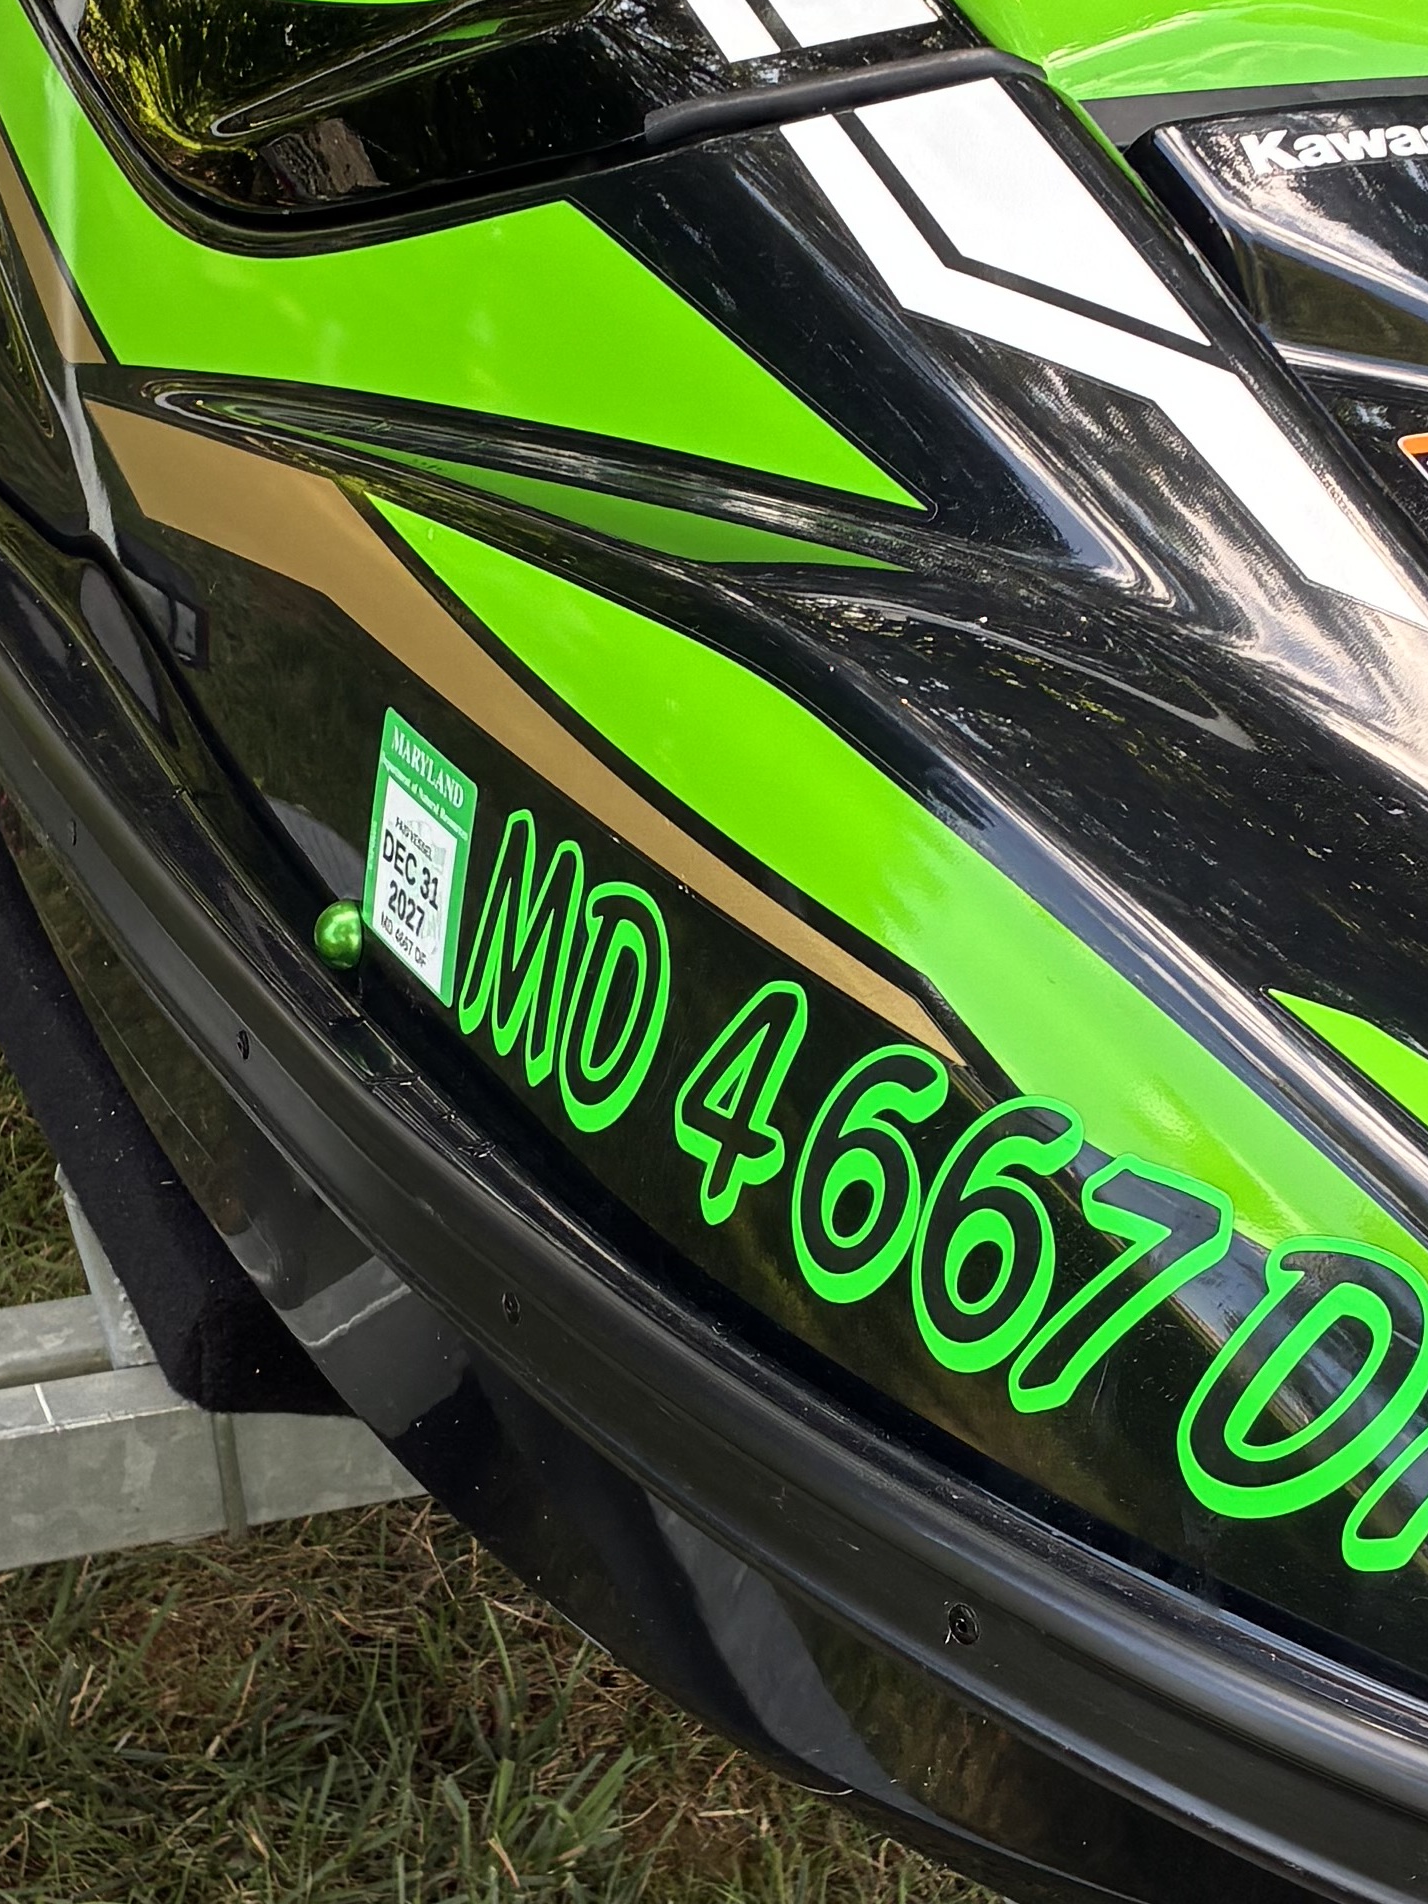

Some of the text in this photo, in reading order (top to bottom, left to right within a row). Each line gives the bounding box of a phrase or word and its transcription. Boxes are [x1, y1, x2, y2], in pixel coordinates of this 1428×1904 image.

[391, 724, 464, 809] MARYLAND
[383, 828, 417, 886] DEC
[420, 866, 439, 911] 31
[388, 879, 425, 937] 2027
[461, 810, 671, 1132] MD
[674, 981, 1233, 1414] 4667
